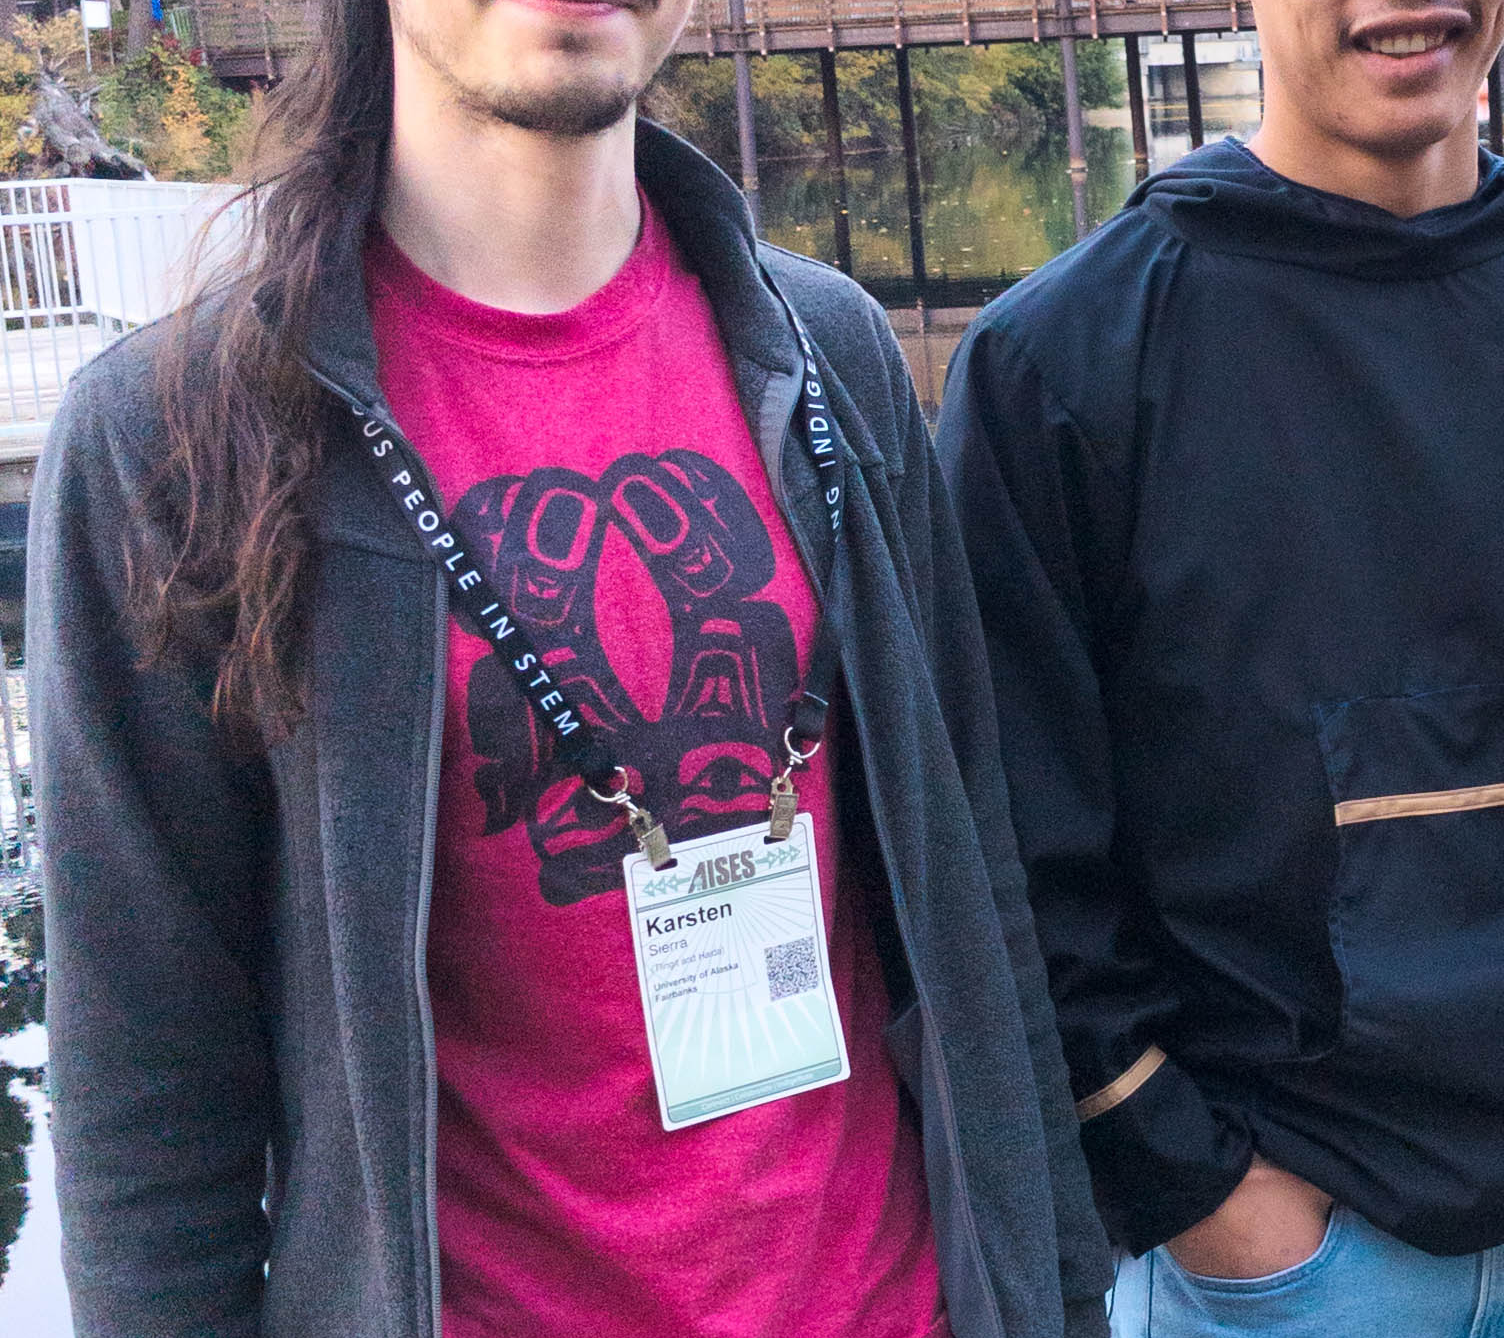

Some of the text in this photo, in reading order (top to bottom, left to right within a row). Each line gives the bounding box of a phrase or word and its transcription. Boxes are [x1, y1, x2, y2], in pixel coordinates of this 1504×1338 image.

[392, 470, 482, 591] PEOPLE
[480, 603, 515, 640] IN
[514, 653, 580, 736] STEM
[688, 849, 757, 894] AISES
[646, 902, 733, 937] Karsten
[648, 938, 689, 957] Sierra
[653, 962, 740, 992] University of Alaska
